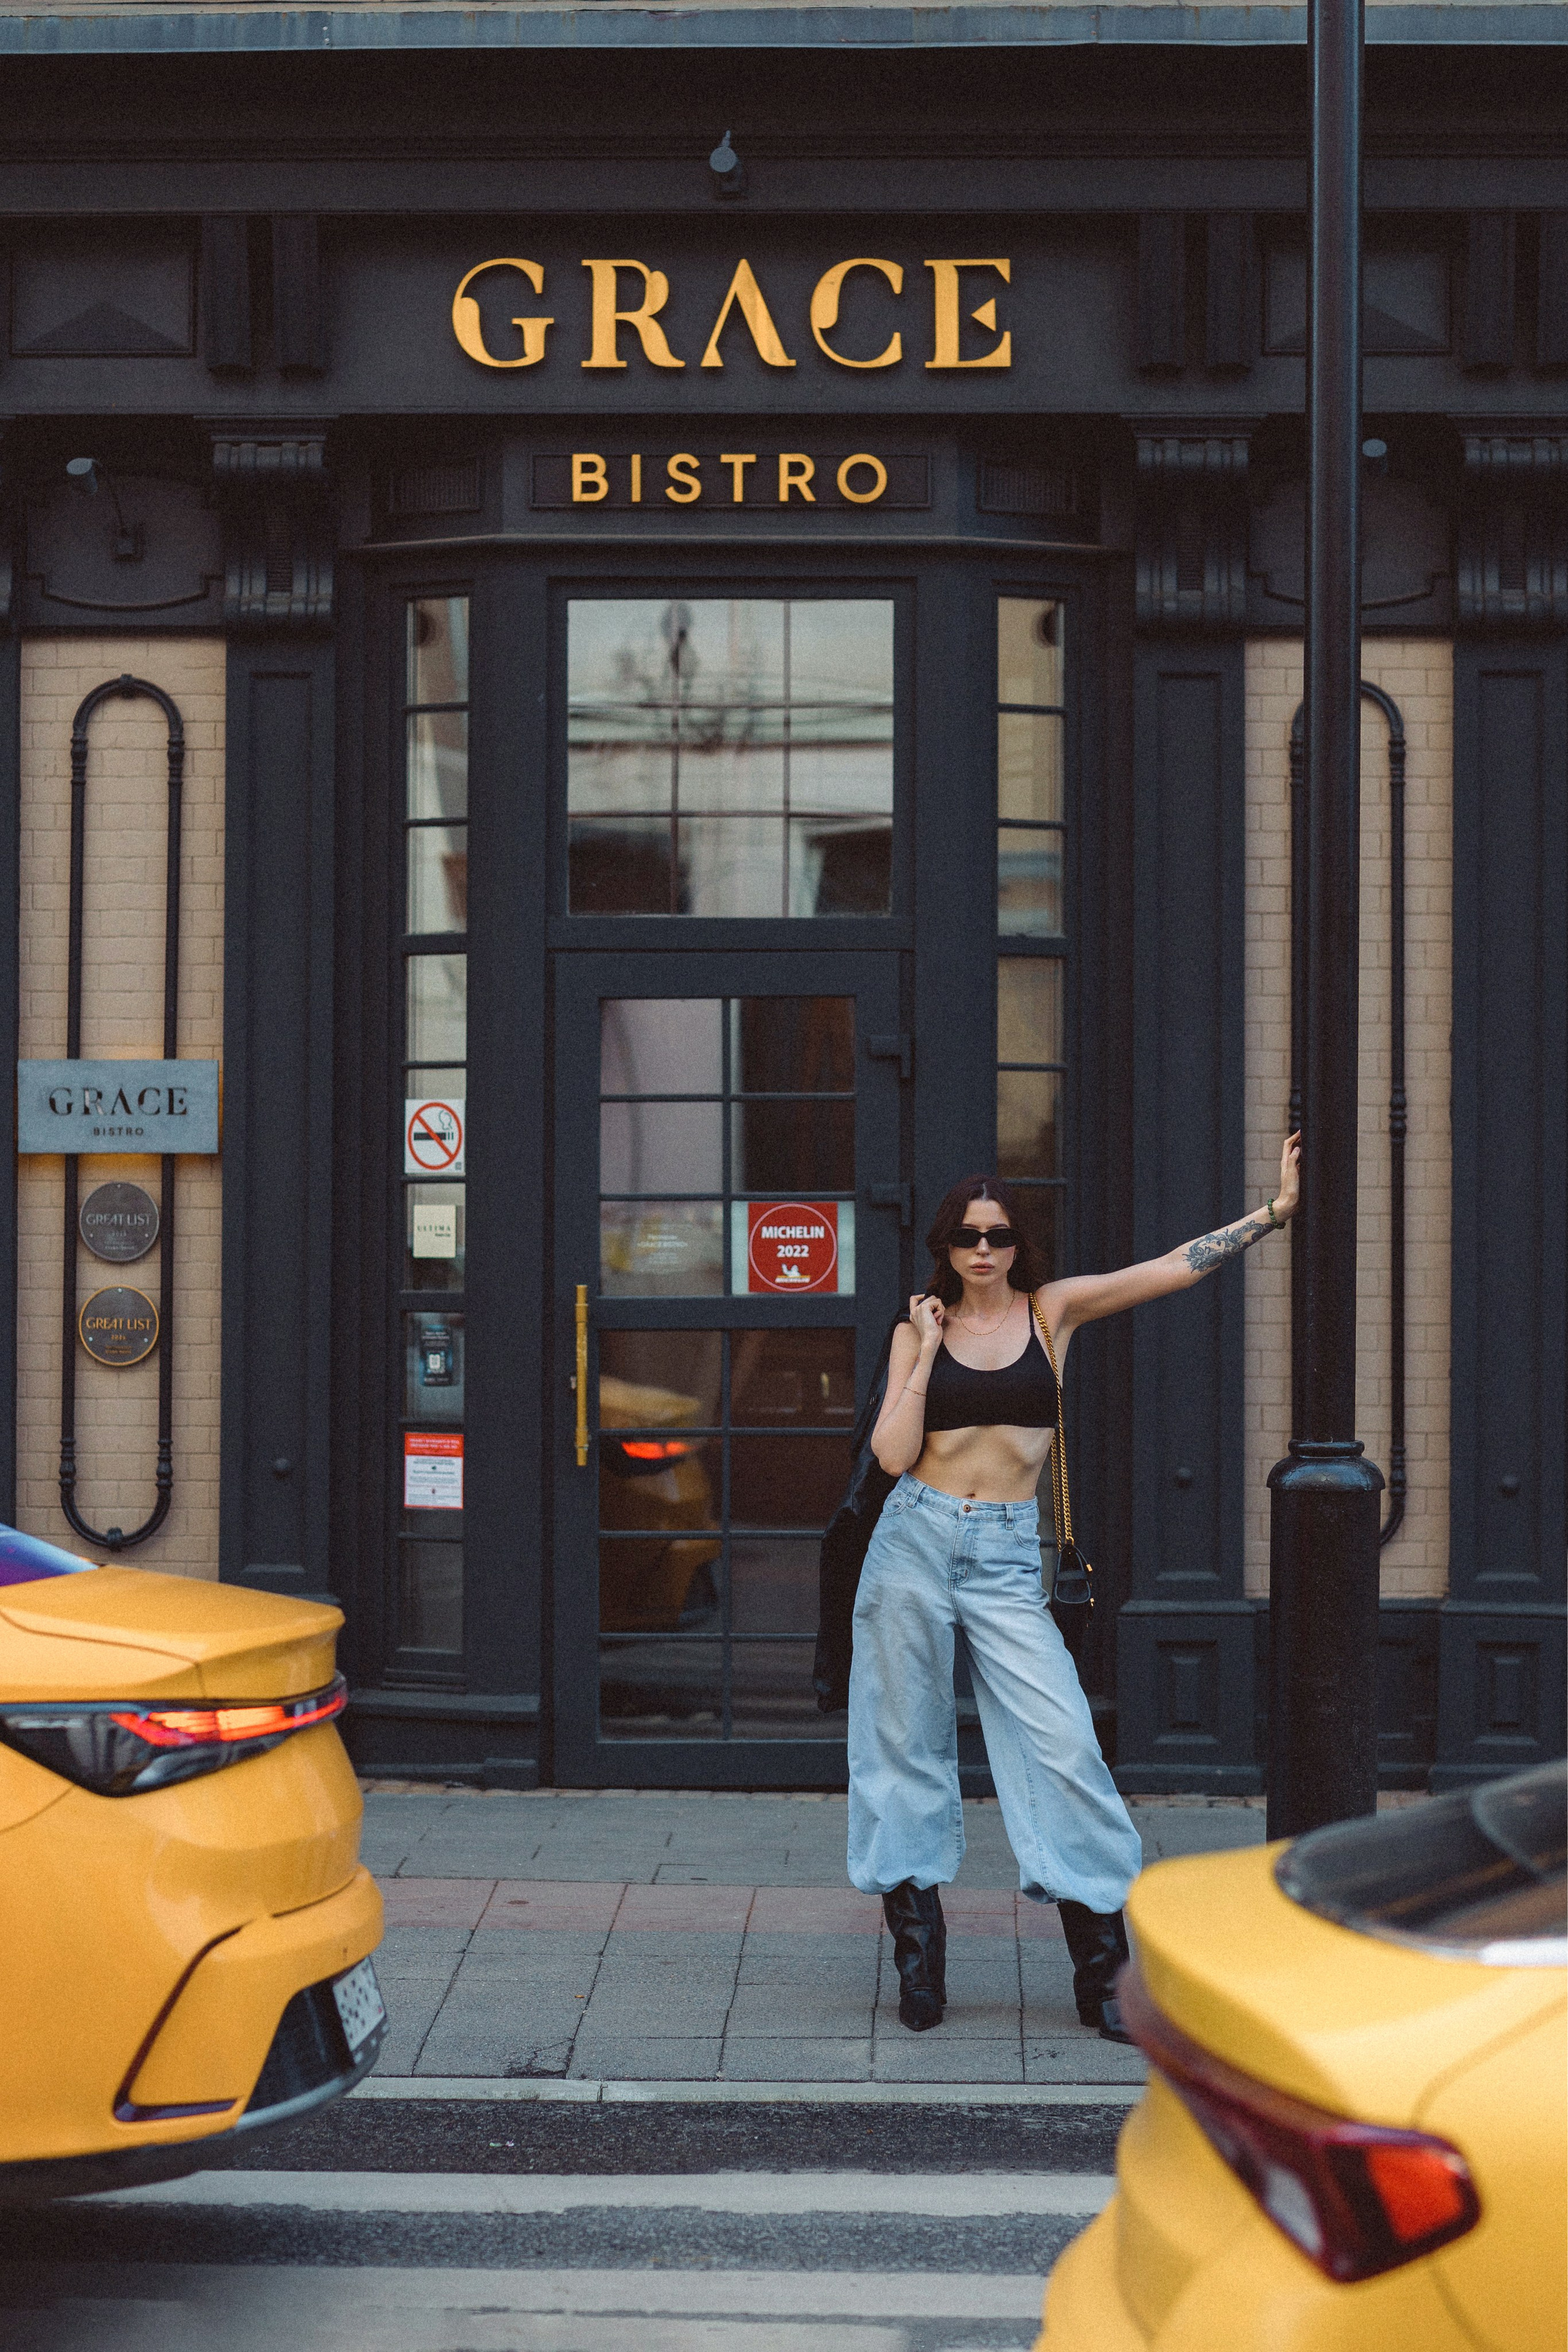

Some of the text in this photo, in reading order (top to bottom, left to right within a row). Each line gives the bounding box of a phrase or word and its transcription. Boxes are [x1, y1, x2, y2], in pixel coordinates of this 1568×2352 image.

[451, 257, 1012, 369] GRACE
[571, 453, 888, 503] BISTRO
[48, 1087, 187, 1115] GRACE
[93, 1126, 144, 1137] BISTRO
[86, 1213, 152, 1226] GREAT LIST
[761, 1226, 825, 1239] MICHELIN
[776, 1245, 810, 1257] 2022
[86, 1317, 153, 1330] GREAT LIST
